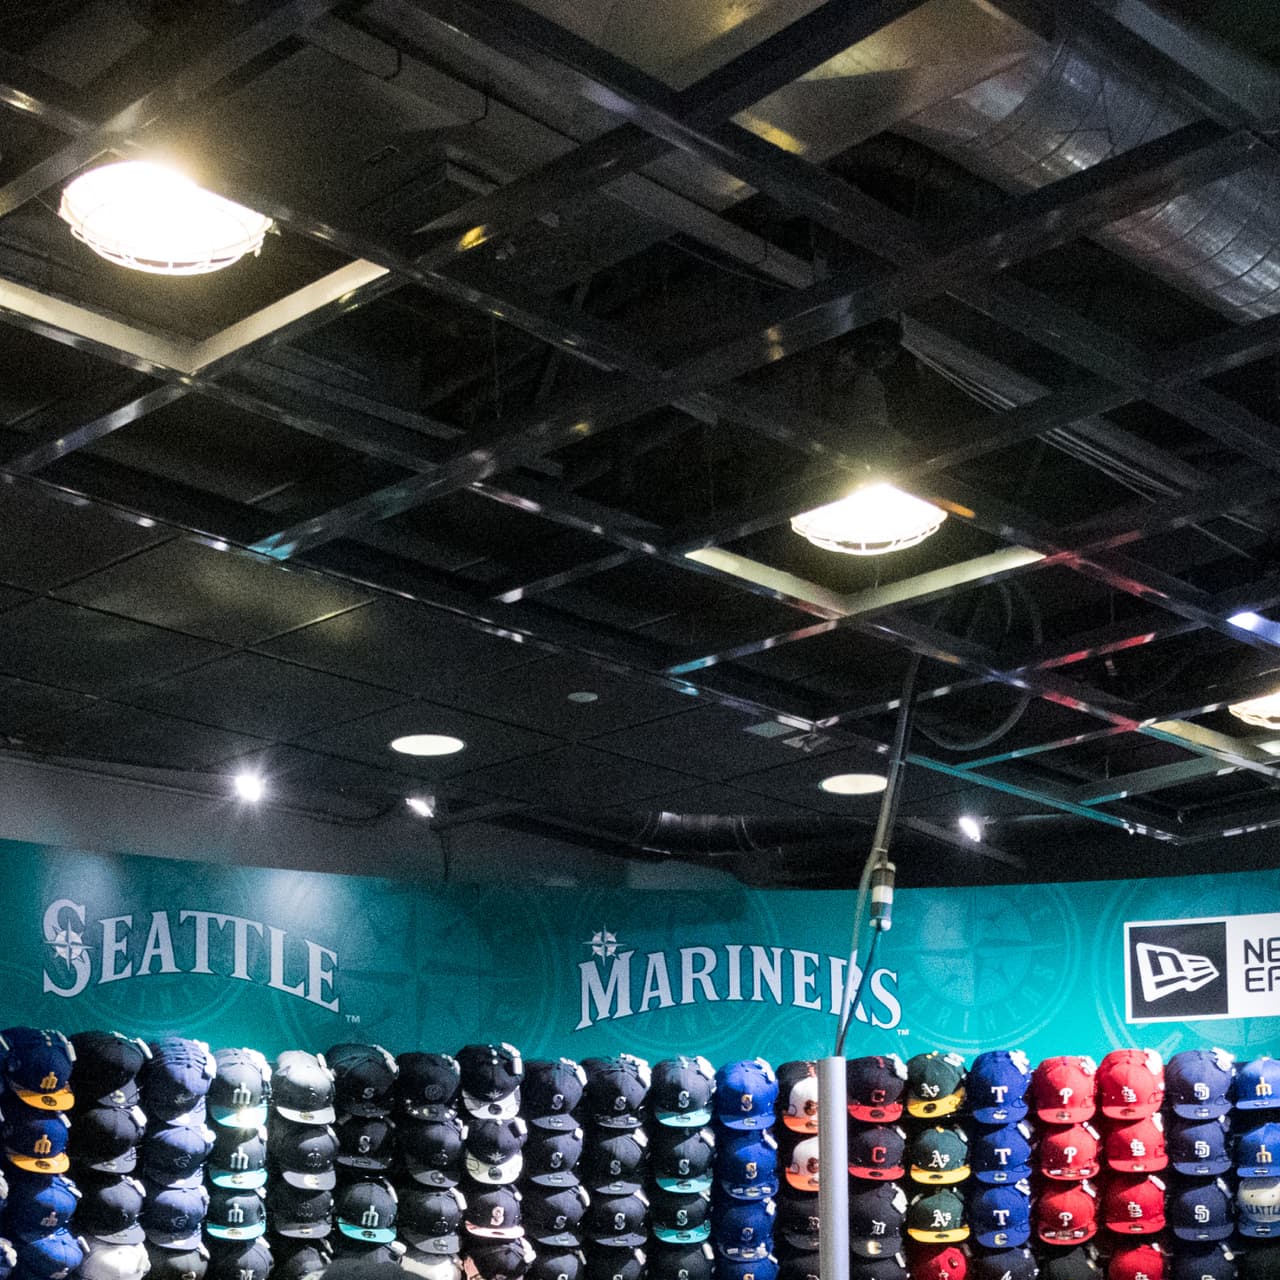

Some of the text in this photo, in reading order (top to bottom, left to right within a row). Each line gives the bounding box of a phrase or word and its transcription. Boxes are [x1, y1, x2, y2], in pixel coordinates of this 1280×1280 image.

[43, 898, 340, 1013] SEATTLE
[574, 942, 903, 1032] MARINERS
[1059, 1088, 1073, 1104] P
[1064, 1147, 1077, 1163] P
[1059, 1212, 1072, 1226] P
